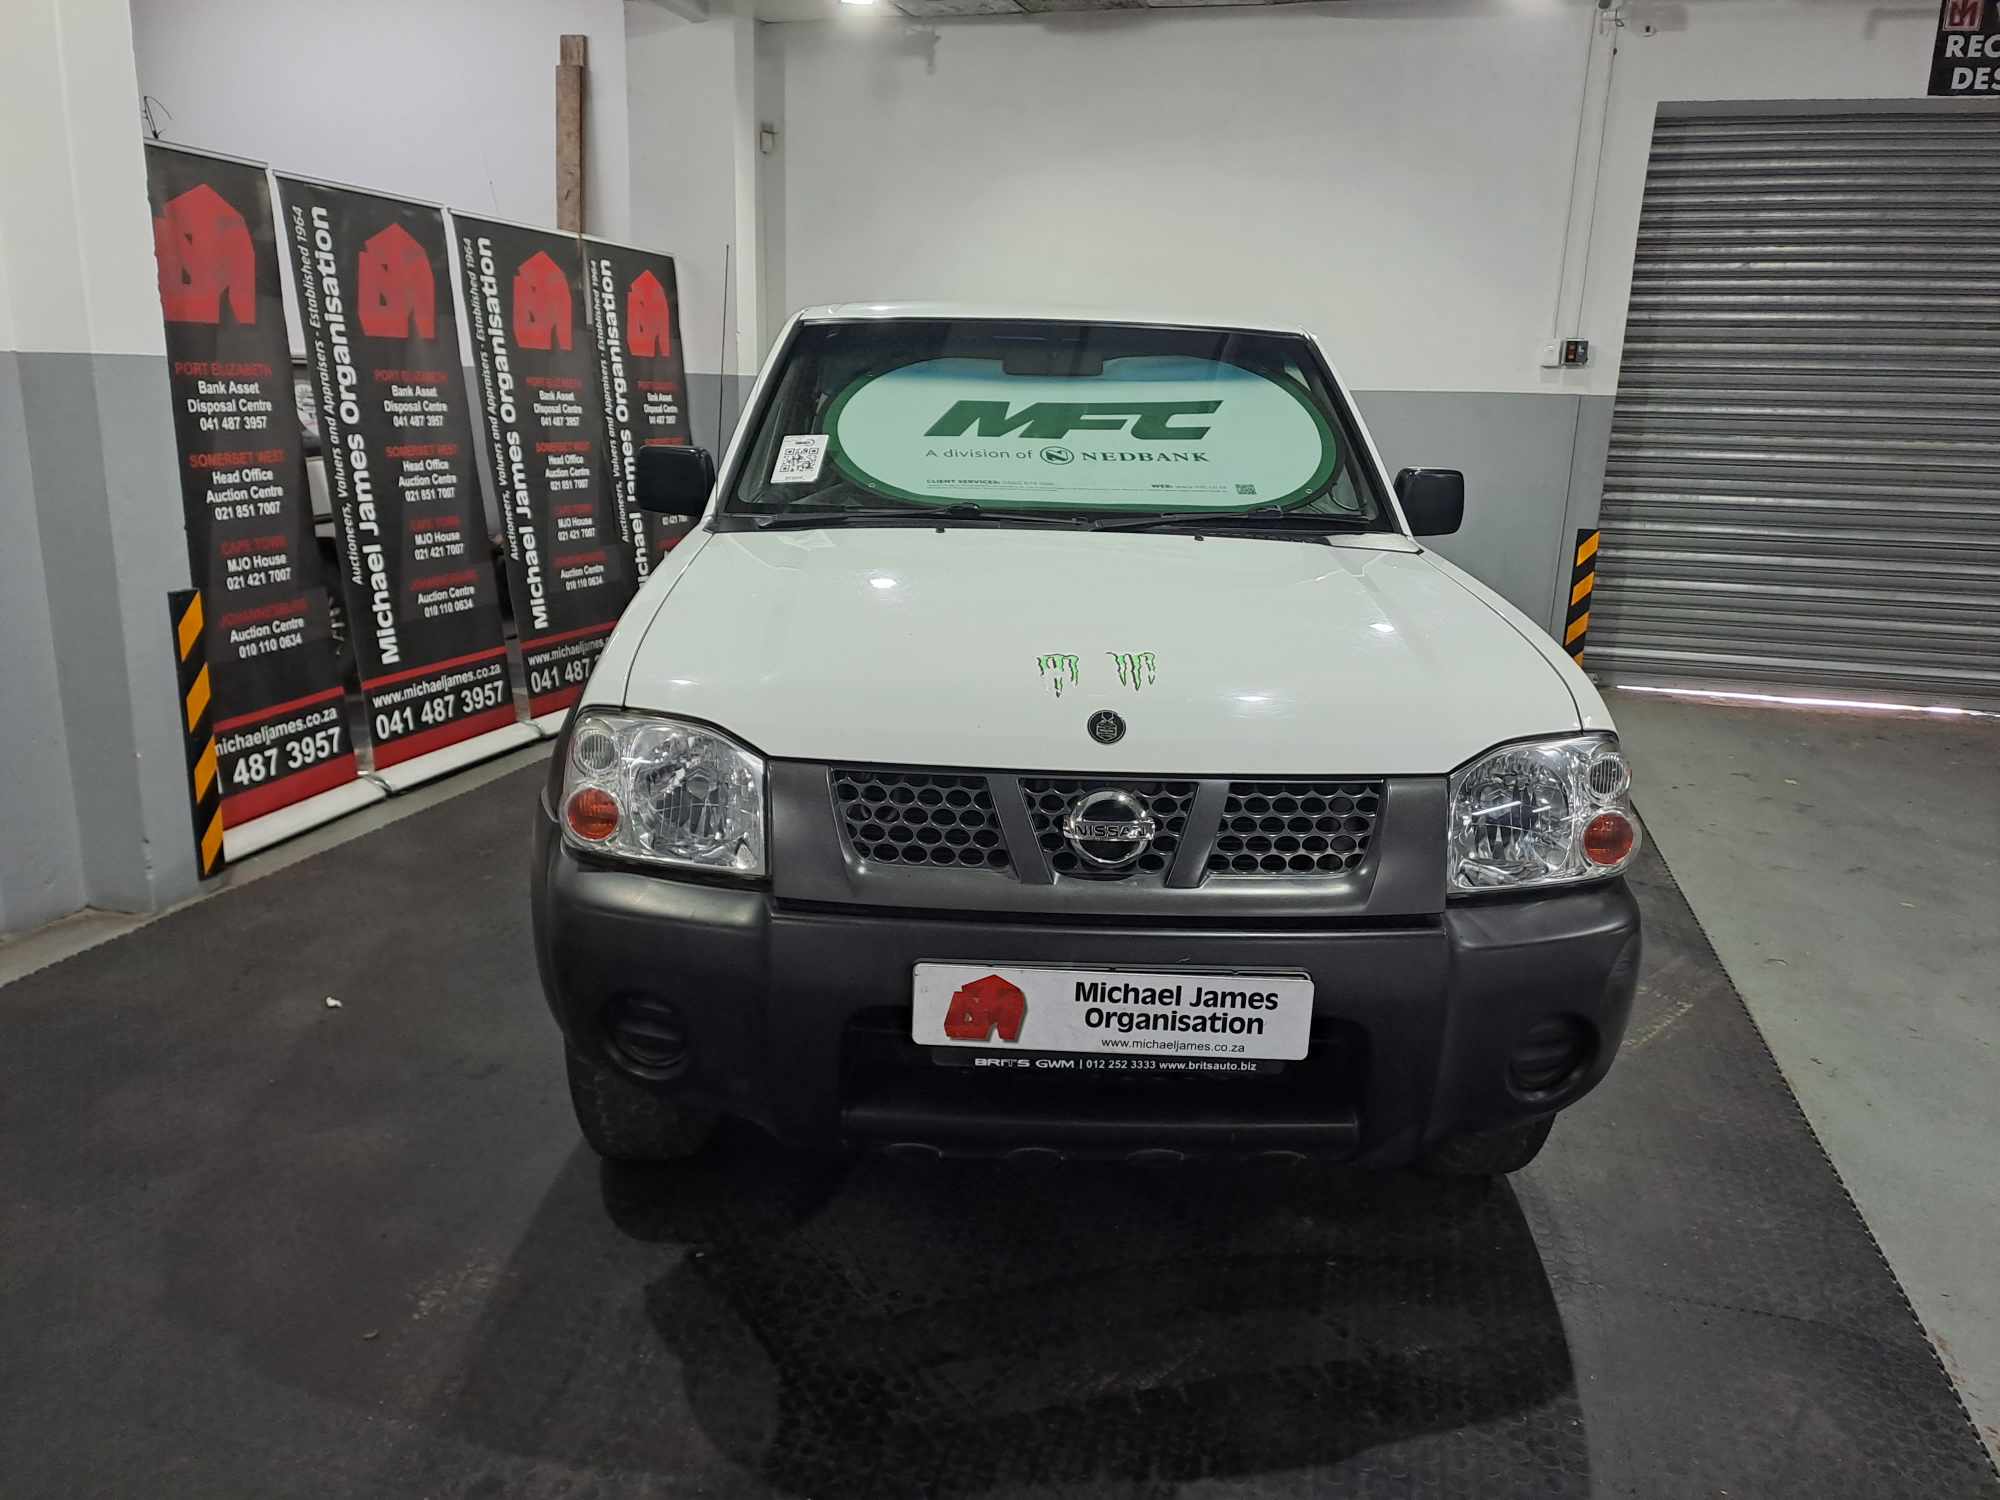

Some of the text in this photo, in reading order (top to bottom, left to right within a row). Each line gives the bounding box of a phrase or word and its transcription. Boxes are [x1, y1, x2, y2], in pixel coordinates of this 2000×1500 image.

[292, 205, 308, 242] 1964
[462, 237, 476, 268] 1964
[298, 245, 321, 328] Established
[467, 270, 486, 342] Established
[198, 381, 260, 394] Bank Asset
[314, 341, 336, 415] Appraisers
[481, 350, 499, 416] Appraisers
[600, 360, 615, 416] Appraisers
[391, 385, 437, 397] Bank Asset
[187, 399, 272, 415] Disposal Centre
[384, 400, 448, 413] Disposal Centre
[200, 416, 267, 431] 041 487 3957
[326, 416, 340, 445] and
[393, 416, 408, 427] 041
[410, 416, 424, 426] 487
[488, 416, 500, 441] and
[606, 417, 617, 440] and
[923, 400, 1224, 440] MFC
[311, 206, 400, 665] Michael James Organisation
[477, 237, 549, 630] Michael James Organisation
[403, 459, 448, 472] Head Office
[493, 442, 508, 487] Valuers
[609, 440, 621, 477] Valuers
[925, 448, 1032, 459] A division of
[1082, 451, 1209, 462] NEDBANK
[212, 468, 273, 485] Head Office
[332, 446, 348, 499] Valuers
[399, 474, 456, 487] Auction Centre
[545, 468, 569, 478] Auction
[206, 486, 284, 503] Auction Centre
[215, 501, 280, 520] 021 851 7007
[415, 531, 460, 545] MJO House
[502, 490, 520, 561] Auctioneers,
[341, 503, 363, 586] Auctioneers,
[415, 548, 429, 560] 021
[430, 546, 444, 558] 421
[629, 512, 649, 588] ichael
[226, 554, 286, 572] MJO House
[226, 567, 291, 590] 021 421 7007
[418, 586, 475, 604] Auction Centre
[230, 617, 304, 643] Auction Centre
[238, 644, 258, 659] 010
[259, 640, 278, 654] 110
[373, 663, 501, 709] www.michaeljames.co.za
[531, 658, 590, 693] 041 487
[375, 680, 504, 740] 041 487 3957
[233, 727, 341, 785] 487 3957
[1075, 824, 1146, 837] NISSAN
[1075, 982, 1279, 1010] Michael James
[1085, 1007, 1264, 1035] Organisation
[1101, 1039, 1246, 1053] www.michaeljames.co.za
[975, 1058, 1030, 1067] BRITS
[1035, 1059, 1075, 1069] GWM
[1086, 1059, 1106, 1069] 012
[1108, 1059, 1128, 1069] 252
[1130, 1060, 1156, 1070] 3333
[1158, 1060, 1257, 1071] www.britsauto.biz
